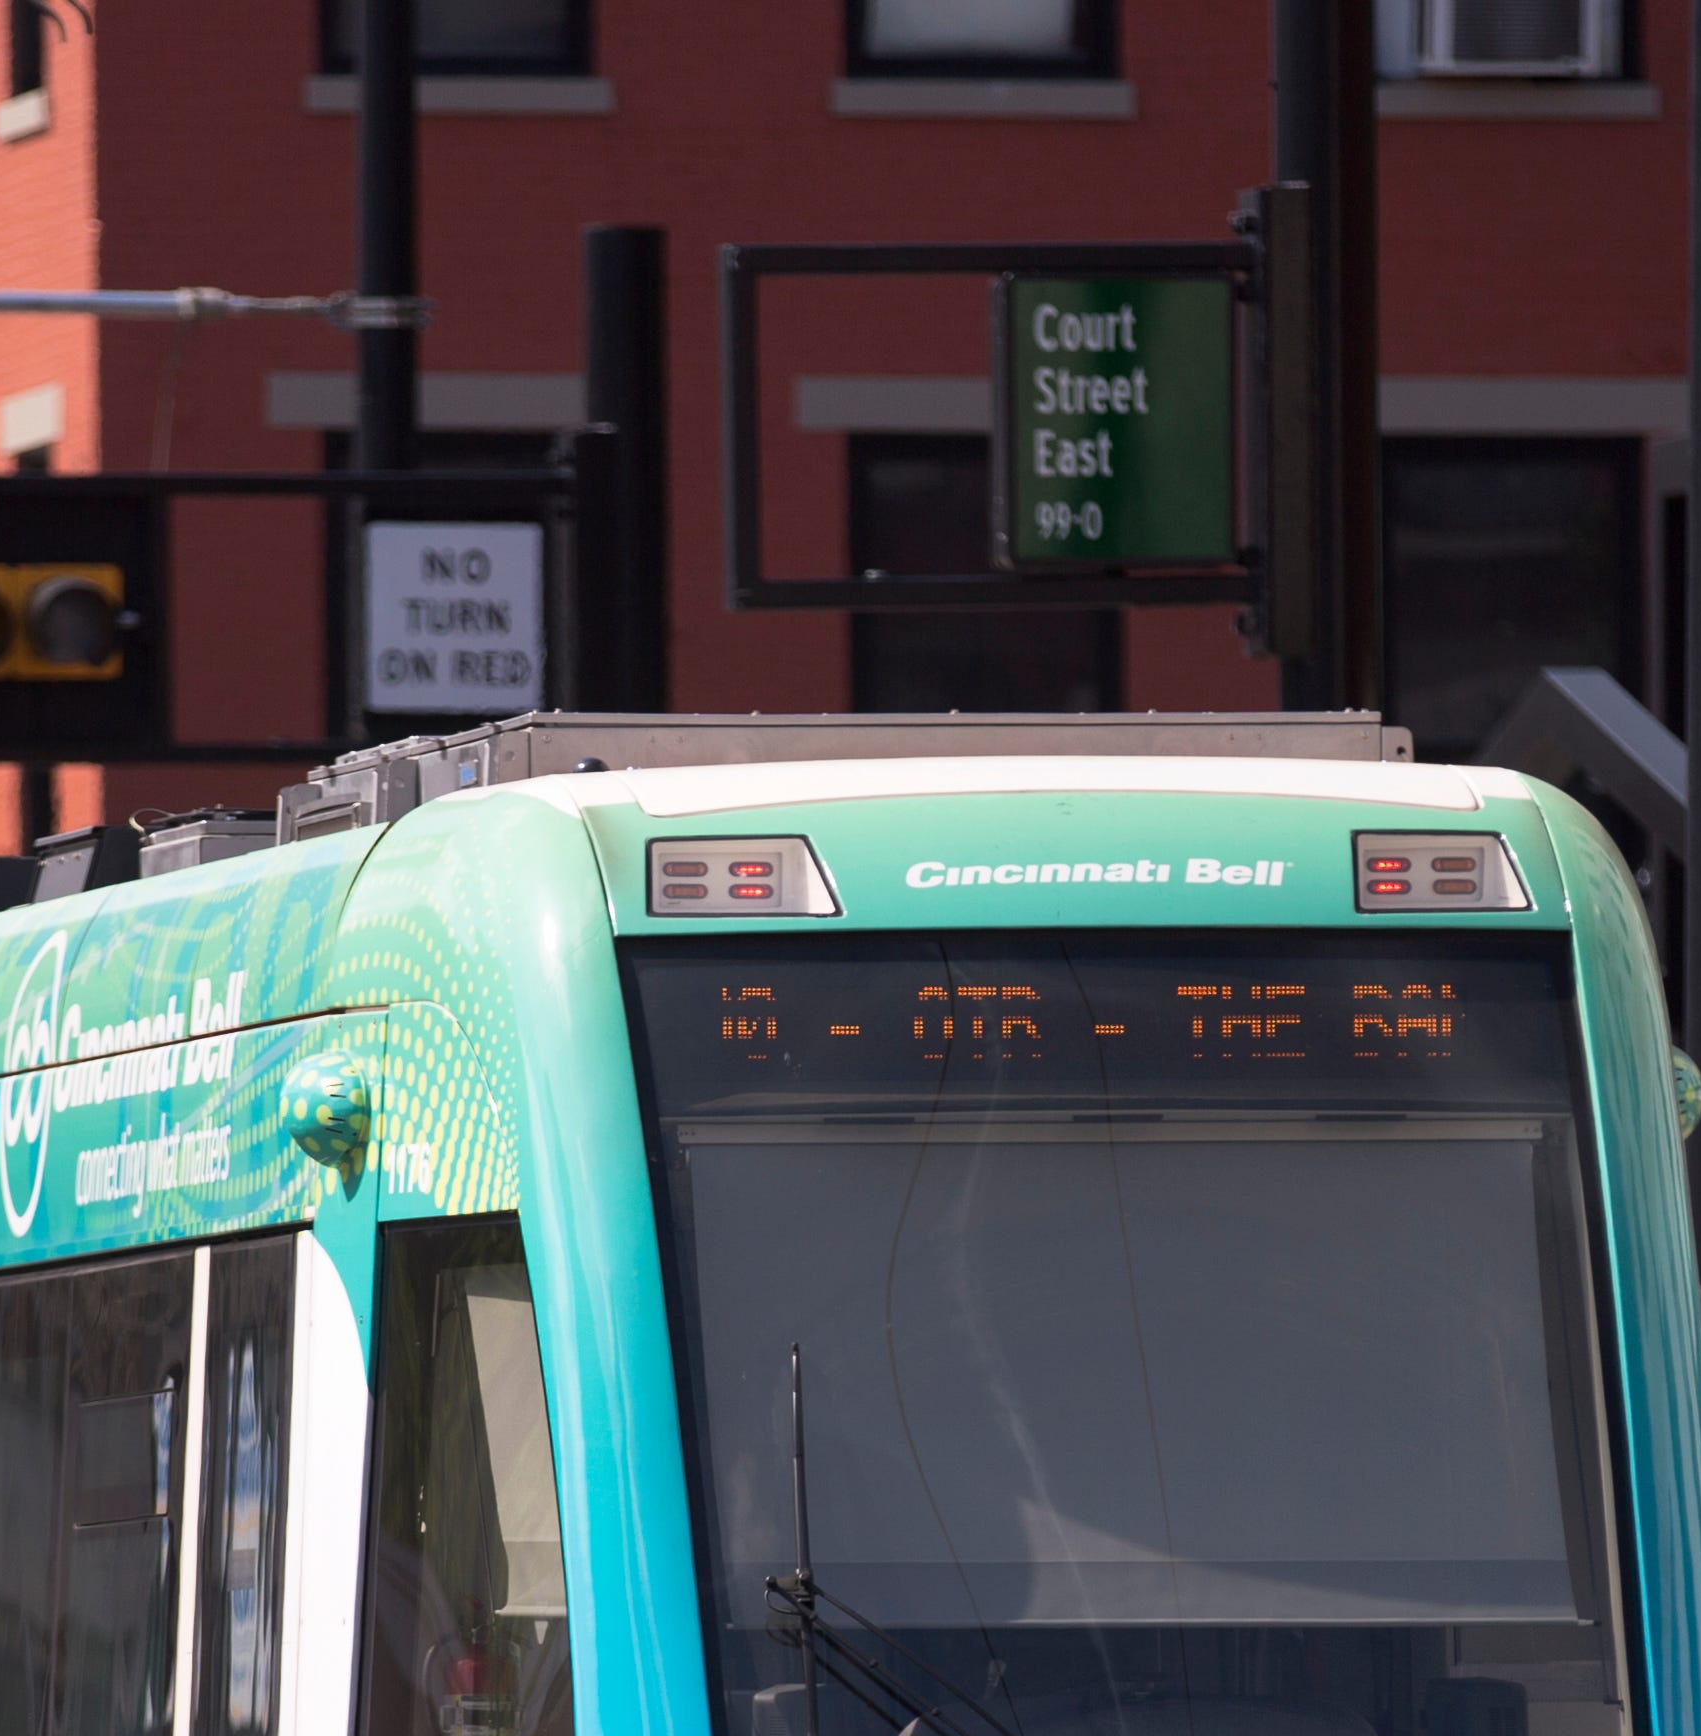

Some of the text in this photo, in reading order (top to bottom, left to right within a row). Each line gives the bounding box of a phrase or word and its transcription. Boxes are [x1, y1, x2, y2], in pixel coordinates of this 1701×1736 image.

[1033, 304, 1137, 351] Court
[1033, 366, 1148, 414] Street
[1033, 429, 1113, 477] East
[420, 547, 491, 584] NO
[403, 598, 512, 634] TURN
[378, 648, 531, 686] ON RED
[905, 858, 1285, 888] Cincinnati Bell
[54, 995, 184, 1112] Cincinnati
[182, 970, 245, 1086] Bell
[75, 1112, 231, 1218] connecting what matters
[389, 1142, 431, 1194] 1176
